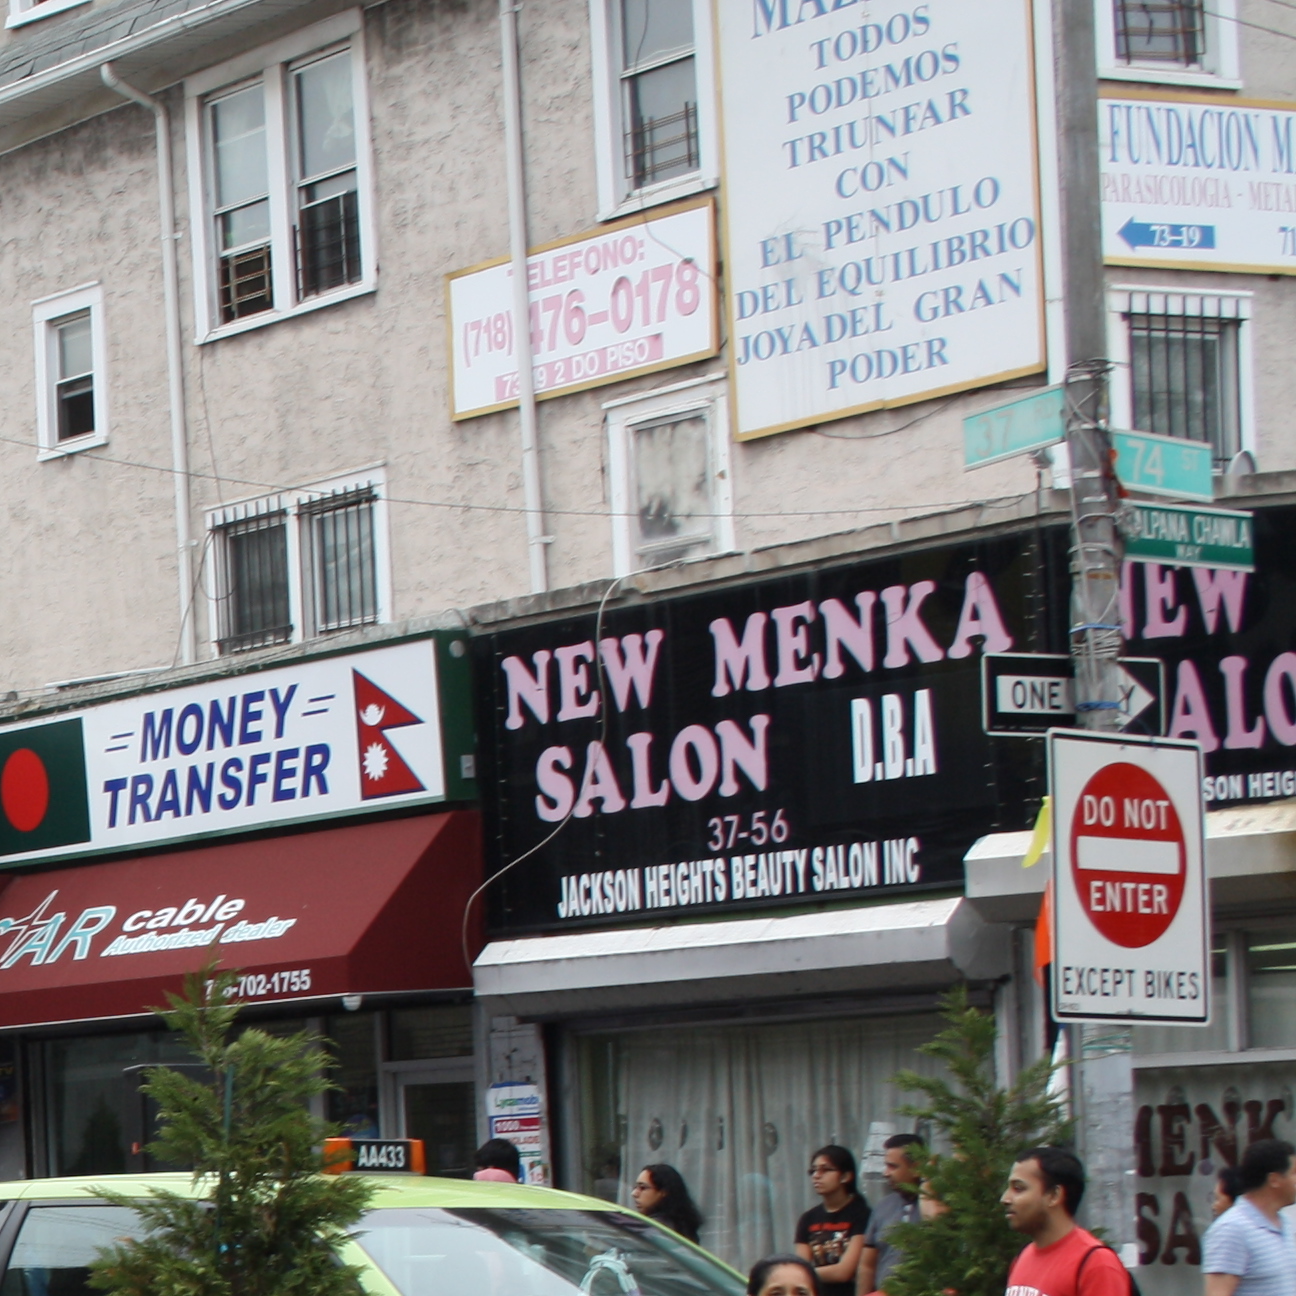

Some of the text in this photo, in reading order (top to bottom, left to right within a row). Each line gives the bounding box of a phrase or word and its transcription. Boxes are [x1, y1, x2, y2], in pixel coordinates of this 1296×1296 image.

[809, 4, 930, 71] TODOS
[786, 41, 961, 124] PODEMOS
[783, 87, 972, 171] TRIUNFAR
[1108, 104, 1259, 171] FUNDACION
[834, 152, 910, 200] CON
[1102, 172, 1231, 209] PARASICOLOGIA
[759, 175, 1000, 271] EL PENDULO
[1149, 225, 1202, 248] 73-19
[507, 235, 645, 291] ELEFONO:
[734, 216, 1037, 322] DEL EQUILIBRIO
[463, 257, 700, 368] (718) 476-0178
[913, 267, 1023, 325] GRAN
[554, 361, 565, 383] 2
[571, 354, 599, 379] DO
[607, 338, 650, 370] PISO
[827, 337, 949, 391] PODER
[977, 409, 1014, 458] 37
[1126, 440, 1201, 487] 74 ST
[1127, 508, 1252, 549] ALPANA CHAWLA
[1175, 543, 1203, 561] WAY
[502, 571, 1013, 730] NEW MENKA
[1012, 680, 1063, 709] ONE
[139, 684, 299, 765] MONEY
[536, 689, 937, 823] SALON D.B.A
[103, 743, 332, 829] TRANSFER
[707, 808, 789, 853] 37-56
[1083, 794, 1172, 832] DO NOT
[557, 837, 920, 919] JACKSON HEIGHTS BEAUTY SALON INC
[1090, 881, 1168, 916] ENTER
[100, 916, 298, 957] Authorized dealer
[122, 894, 246, 932] cable
[1063, 966, 1200, 1001] EXCEPT BIKES
[358, 1144, 406, 1168] AA433
